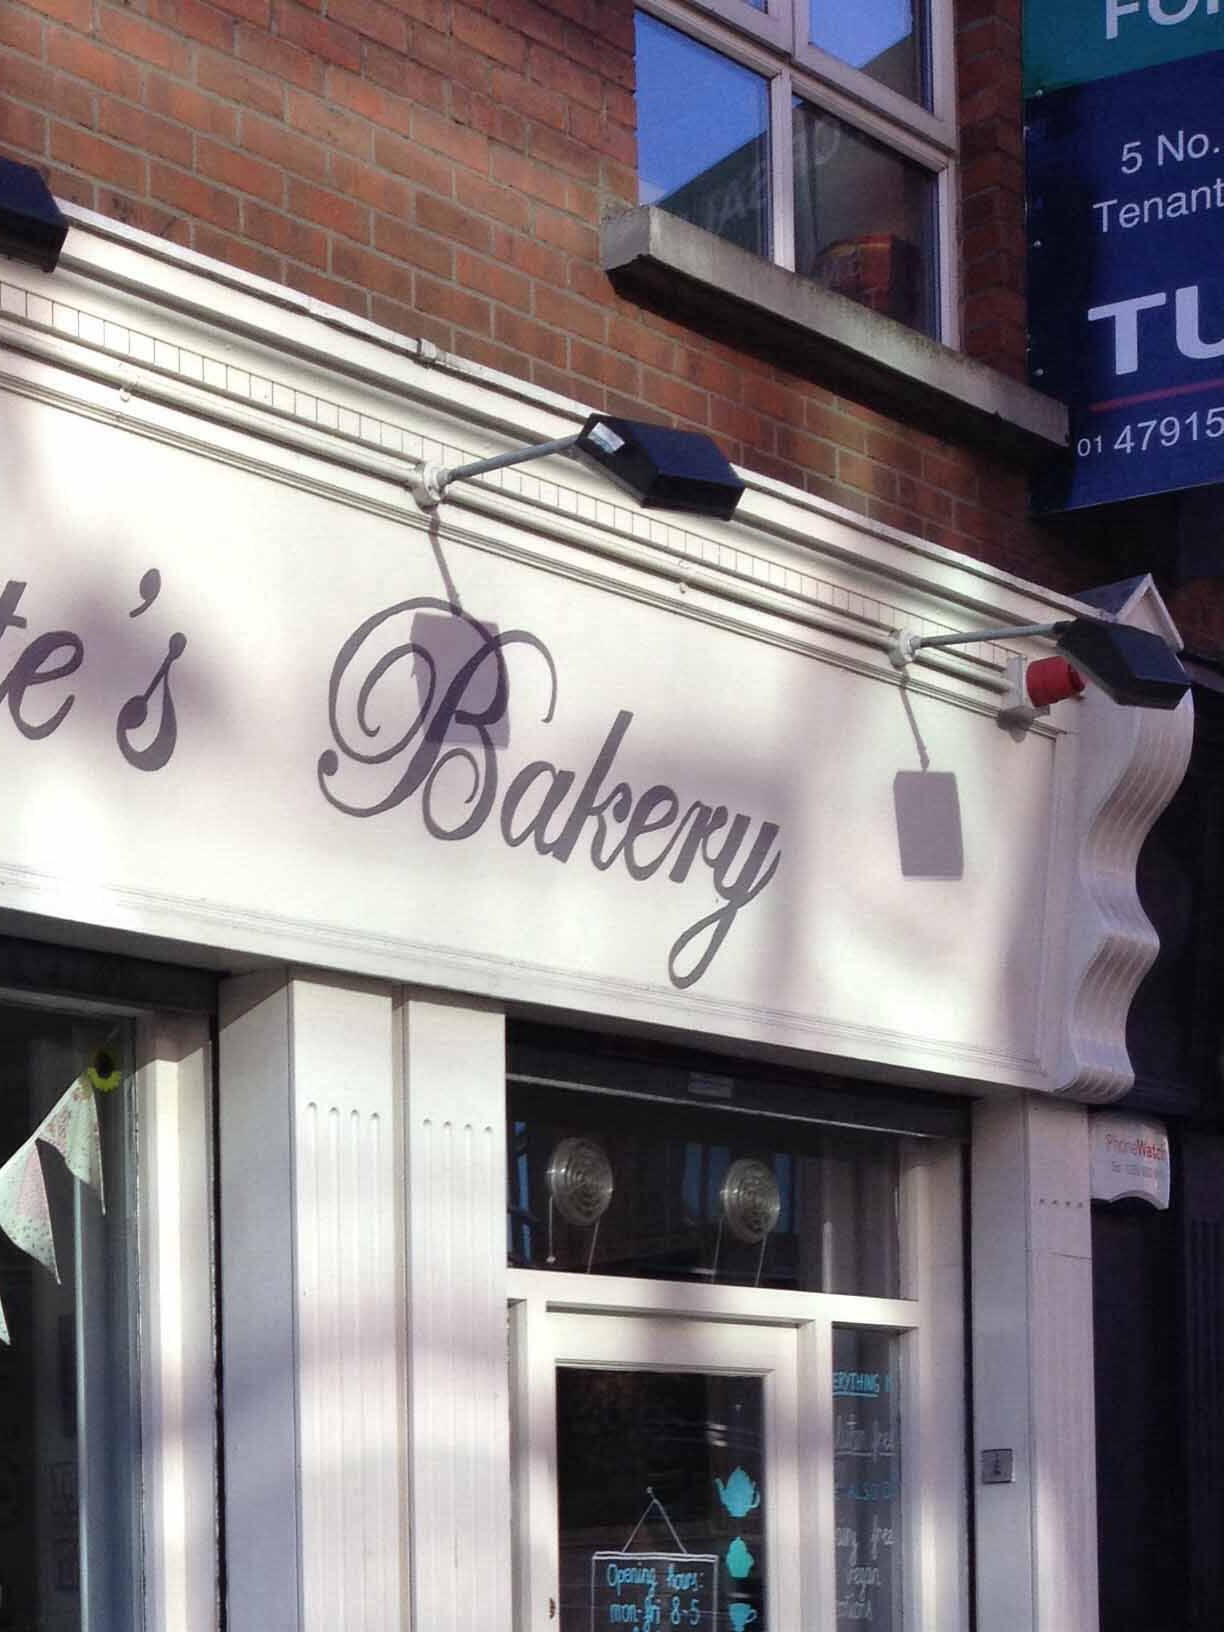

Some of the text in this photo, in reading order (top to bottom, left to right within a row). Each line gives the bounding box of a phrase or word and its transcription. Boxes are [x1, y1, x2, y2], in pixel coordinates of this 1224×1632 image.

[1121, 130, 1220, 174] 5 No.
[1077, 436, 1102, 457] 01
[317, 596, 782, 990] Bakery
[607, 1562, 658, 1597] Opening
